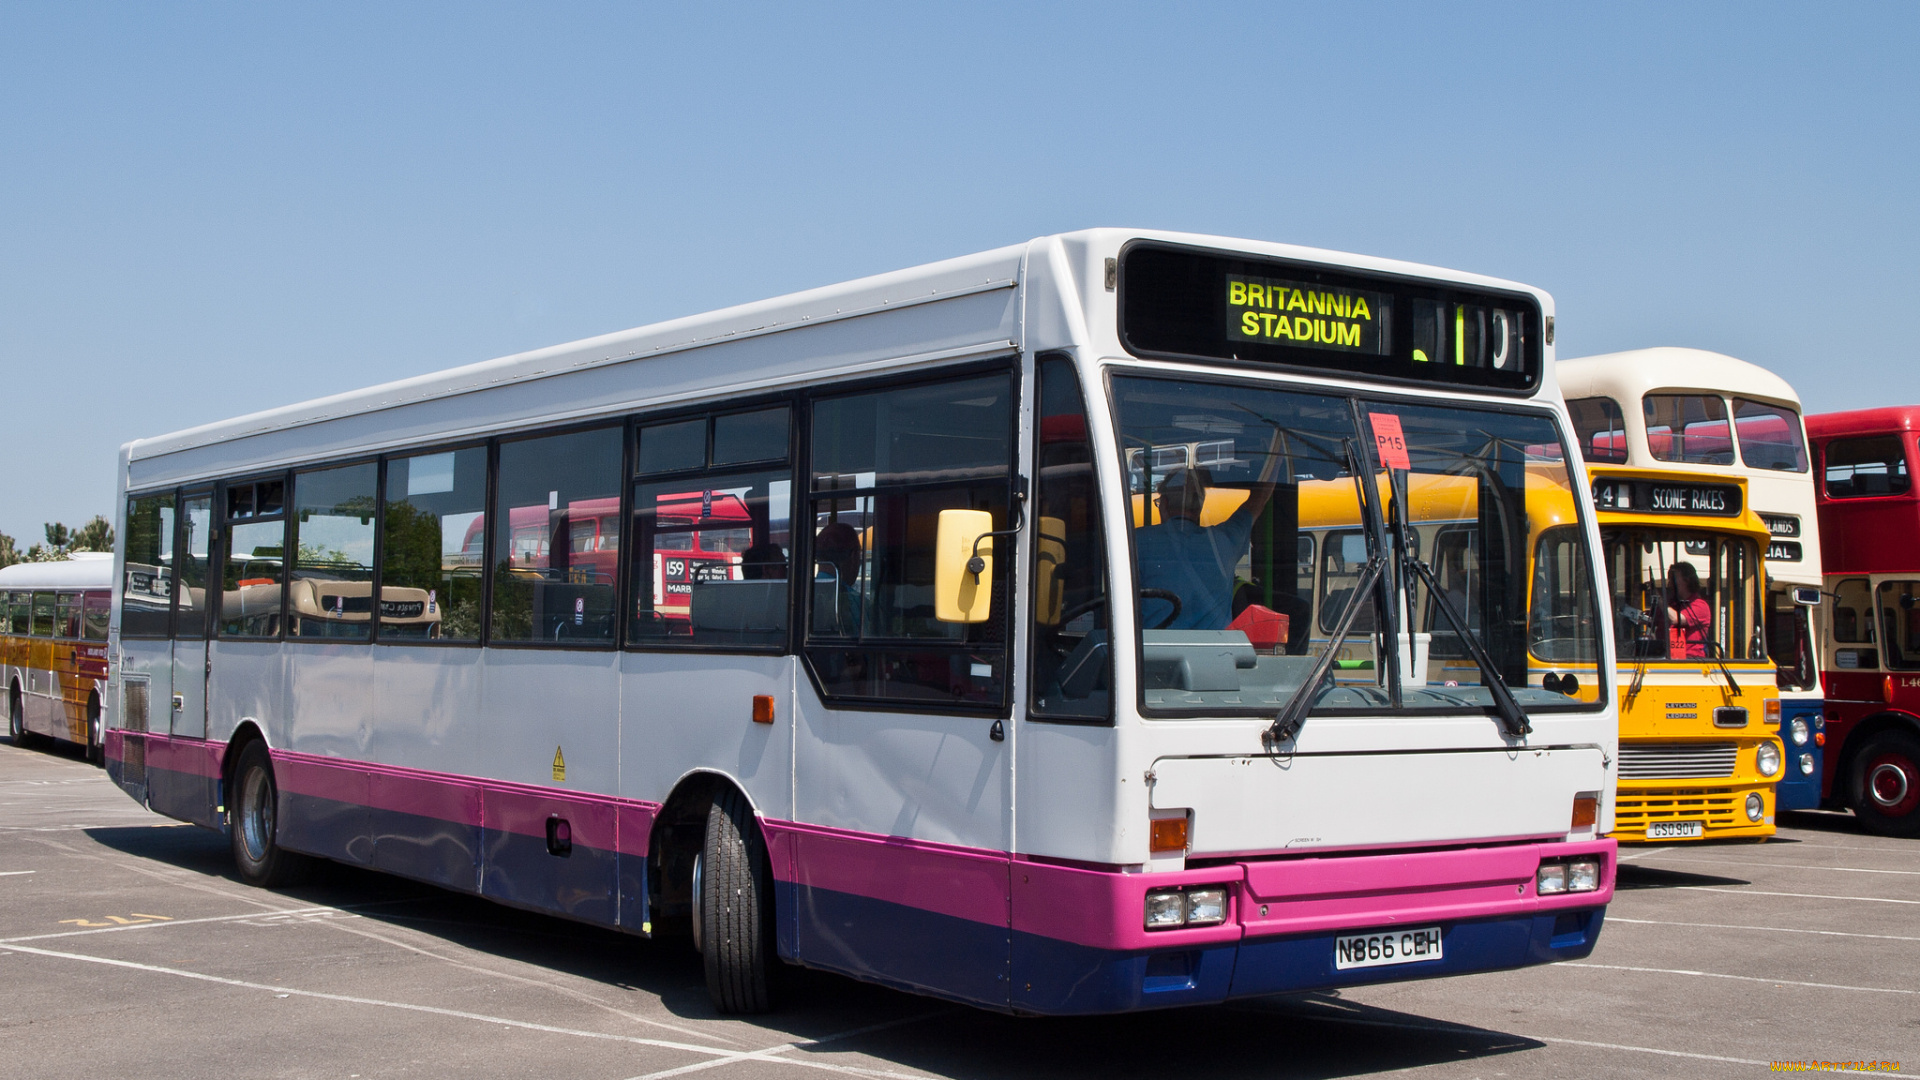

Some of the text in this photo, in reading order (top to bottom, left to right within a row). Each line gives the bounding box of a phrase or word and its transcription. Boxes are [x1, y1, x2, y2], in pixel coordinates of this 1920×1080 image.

[1229, 281, 1372, 321] BRITANNIA
[1240, 311, 1361, 347] STADIUM
[1377, 435, 1403, 450] P15
[1652, 488, 1687, 509] SCONE
[1692, 490, 1726, 511] RACES
[666, 561, 685, 576] 159
[1338, 930, 1439, 963] N866 CEH
